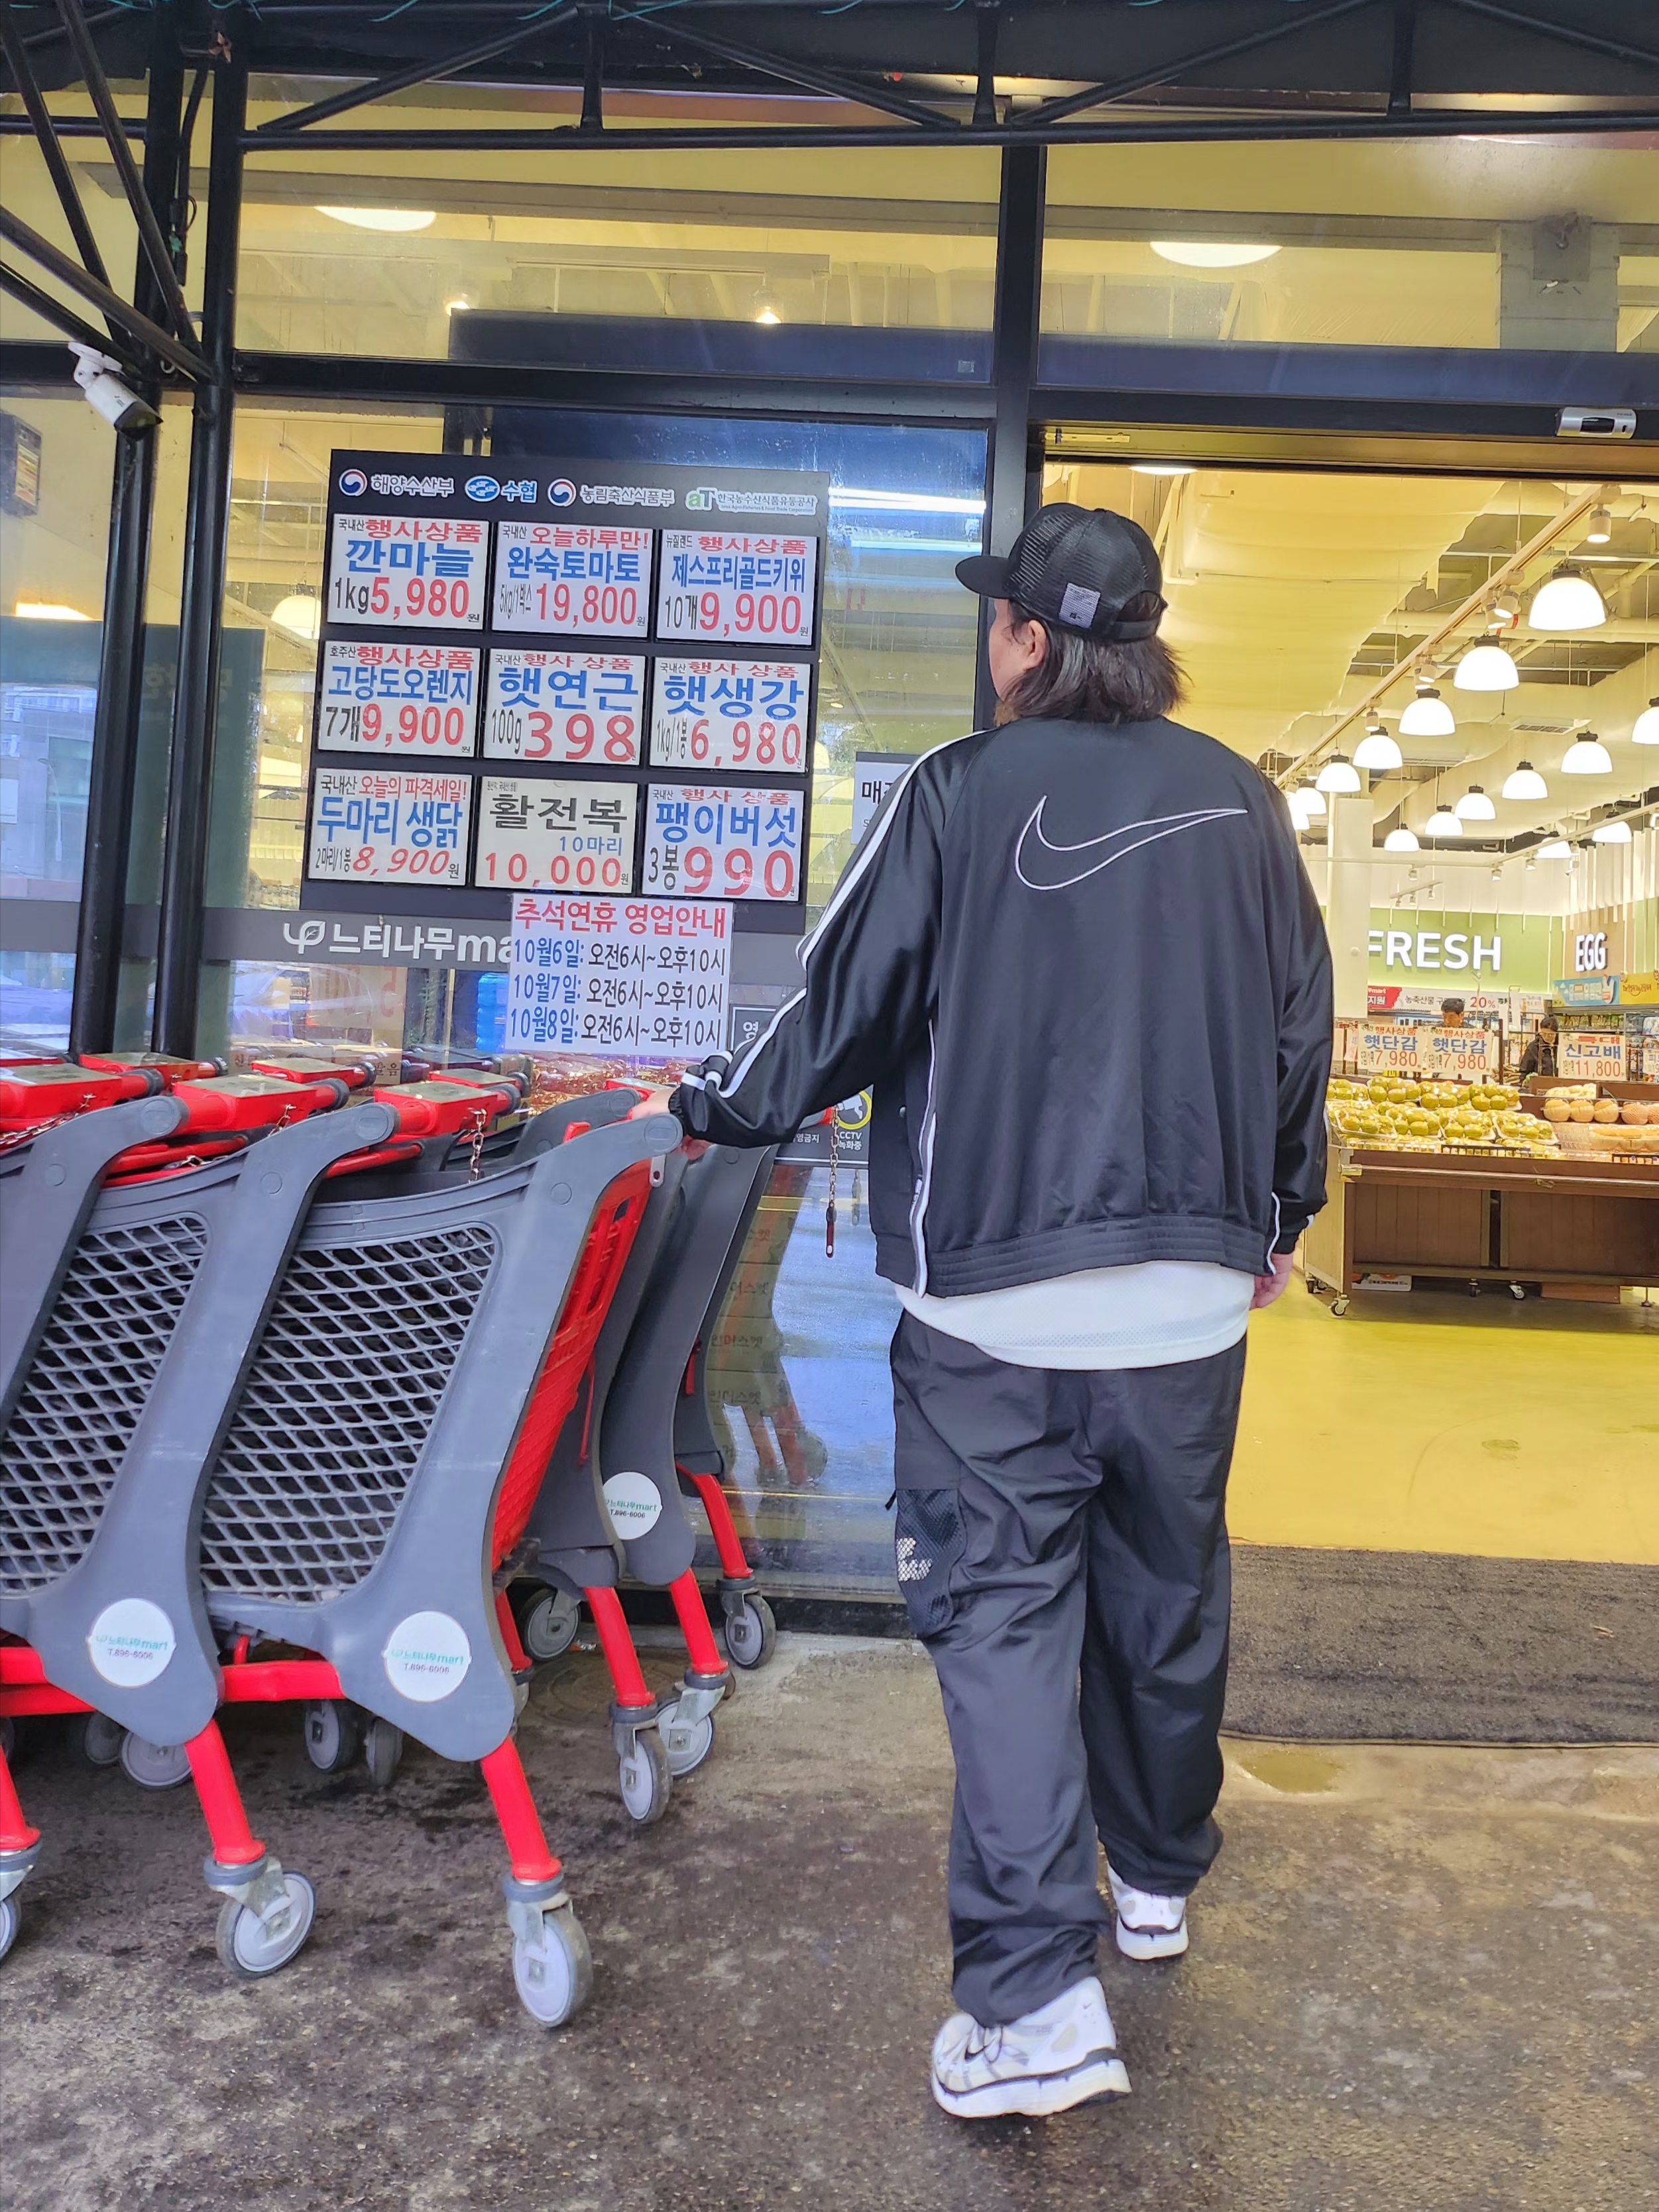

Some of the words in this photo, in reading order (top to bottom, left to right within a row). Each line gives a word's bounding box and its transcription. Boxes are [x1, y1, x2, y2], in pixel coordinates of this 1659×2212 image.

[371, 474, 454, 496] 해양수산부
[502, 480, 537, 503] 수협
[581, 486, 674, 506] 농림축산식품부
[688, 488, 715, 510] aT
[718, 494, 815, 507] 한국농수산식품유통공사
[339, 519, 365, 531] 국내산
[365, 519, 483, 543] 행사상품
[502, 525, 527, 539] 국내산
[698, 536, 808, 555] 행사상품
[346, 539, 474, 577] 깐마늘
[507, 547, 640, 584] 완숙토마토
[671, 553, 806, 593] 제스프리골드키위
[335, 577, 370, 614] 1kg
[665, 595, 698, 630] 10개
[330, 645, 356, 659] 호주산
[357, 646, 475, 670] 행사상품
[494, 654, 522, 666] 국내산
[659, 662, 687, 674] 국내산
[328, 666, 473, 705] 고당도오렌지
[498, 667, 639, 712] 햇연근
[663, 675, 805, 721] 햇생강
[325, 706, 361, 742] 7개
[492, 708, 522, 755] 100g
[524, 711, 636, 762] 398
[321, 775, 357, 795] 국내산
[359, 775, 402, 800] 오늘의
[405, 778, 467, 802] 파격세일!
[652, 789, 674, 801] 국내산
[317, 797, 399, 846] 두마리
[406, 801, 463, 849] 생닭
[489, 793, 628, 834] 활전복
[656, 802, 797, 848] 팽이버섯
[559, 836, 622, 856] 10마리
[683, 846, 795, 898] 990
[515, 898, 618, 933] 추석연휴
[624, 903, 726, 939] 영업안내
[329, 923, 512, 963] 느티나무ma
[514, 937, 585, 968] 10월6일:
[1368, 930, 1502, 971] FRESH
[1575, 932, 1607, 973] EGG
[514, 972, 581, 1005] 10월7일:
[511, 1006, 579, 1044] 10월8일:
[1363, 1034, 1418, 1052] 햇단감
[1432, 1038, 1487, 1054] 햇단감
[1565, 1043, 1621, 1060] 신고배
[793, 1133, 820, 1144] 영금지
[839, 1131, 862, 1140] CCTV
[839, 1140, 862, 1151] 녹화중
